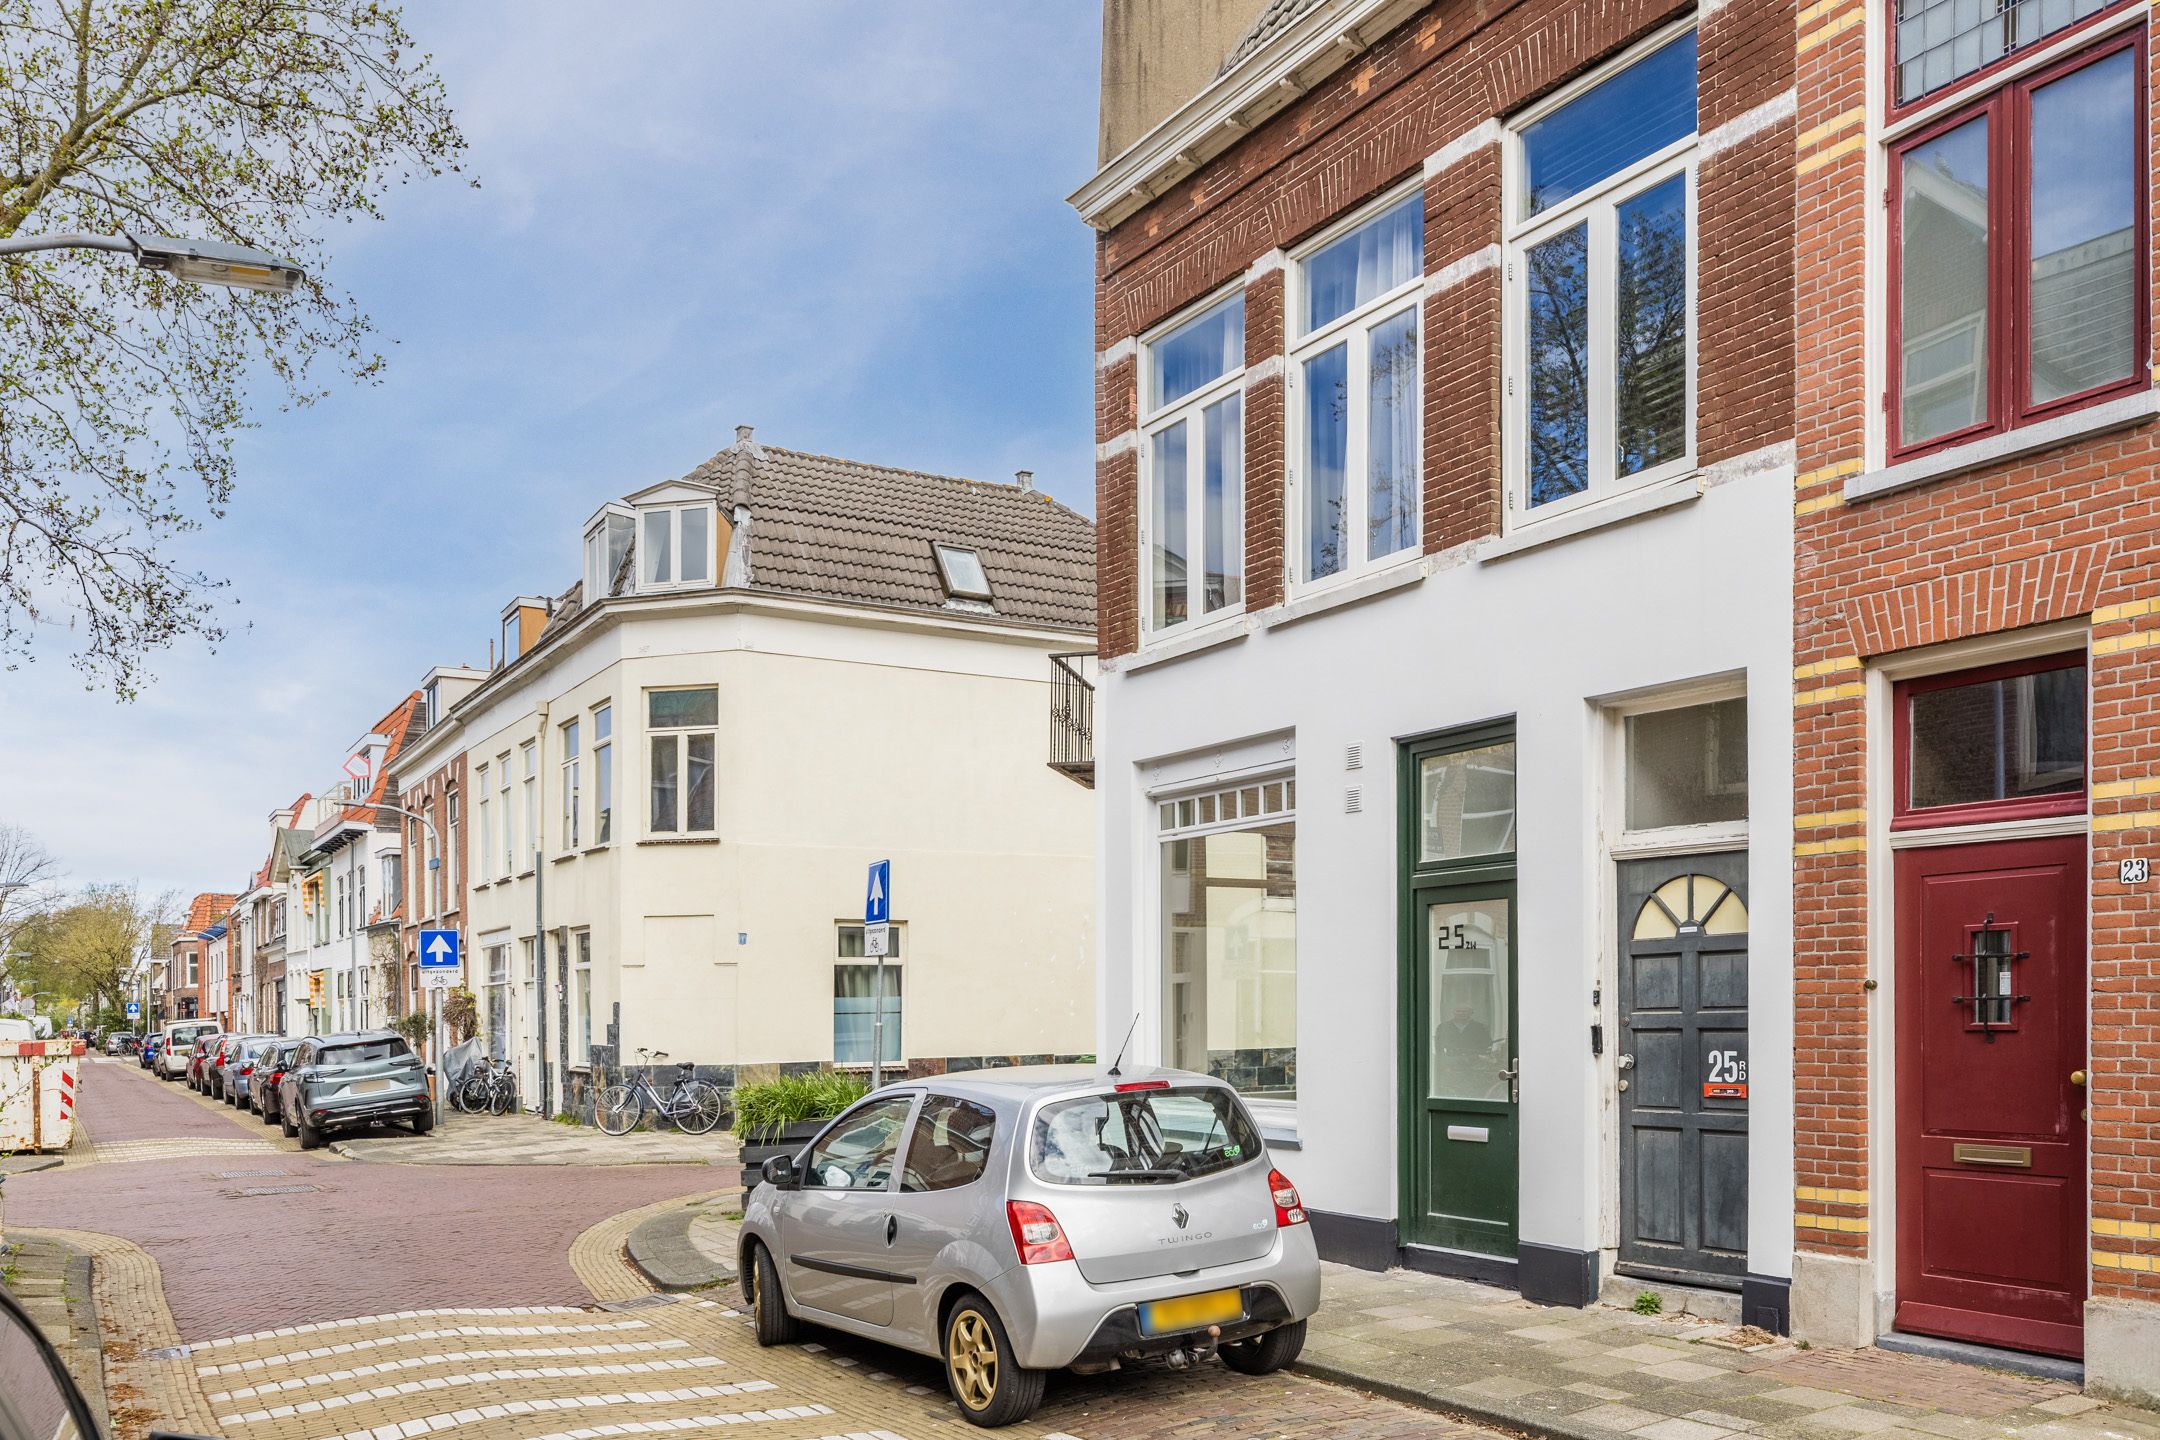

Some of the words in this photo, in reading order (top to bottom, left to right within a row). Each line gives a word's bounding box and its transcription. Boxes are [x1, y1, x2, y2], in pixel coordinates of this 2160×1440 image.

[2123, 859, 2145, 882] 23
[1708, 1050, 1738, 1083] 25
[1158, 1231, 1213, 1246] TWINGO
